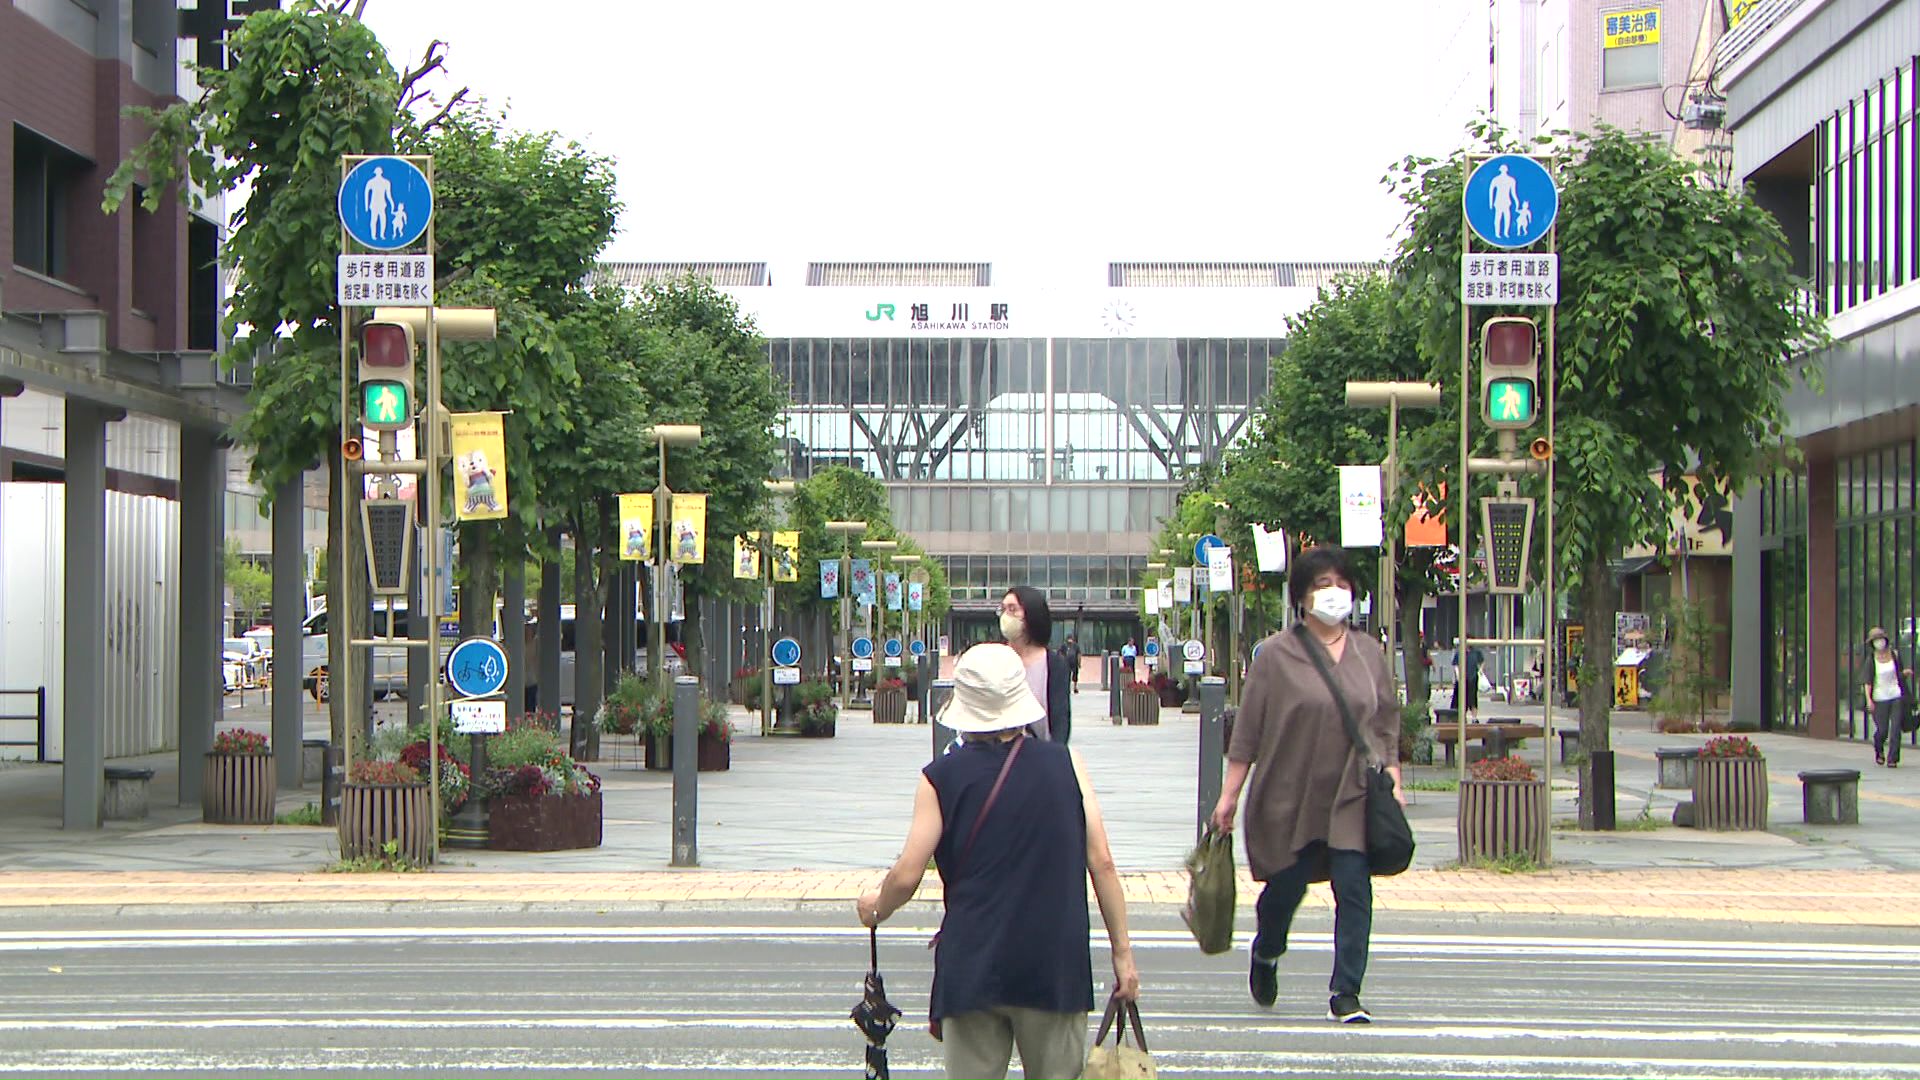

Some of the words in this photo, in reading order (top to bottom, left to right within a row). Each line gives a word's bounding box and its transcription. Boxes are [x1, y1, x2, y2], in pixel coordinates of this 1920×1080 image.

[1606, 12, 1656, 36] 審美治療
[346, 261, 425, 278] 歩行者用道路
[1470, 260, 1549, 276] 歩行者用道路
[866, 303, 895, 321] JR
[911, 303, 1008, 321] 旭川駅
[910, 322, 966, 330] ASAHIKAWA
[971, 322, 1009, 330] STATION
